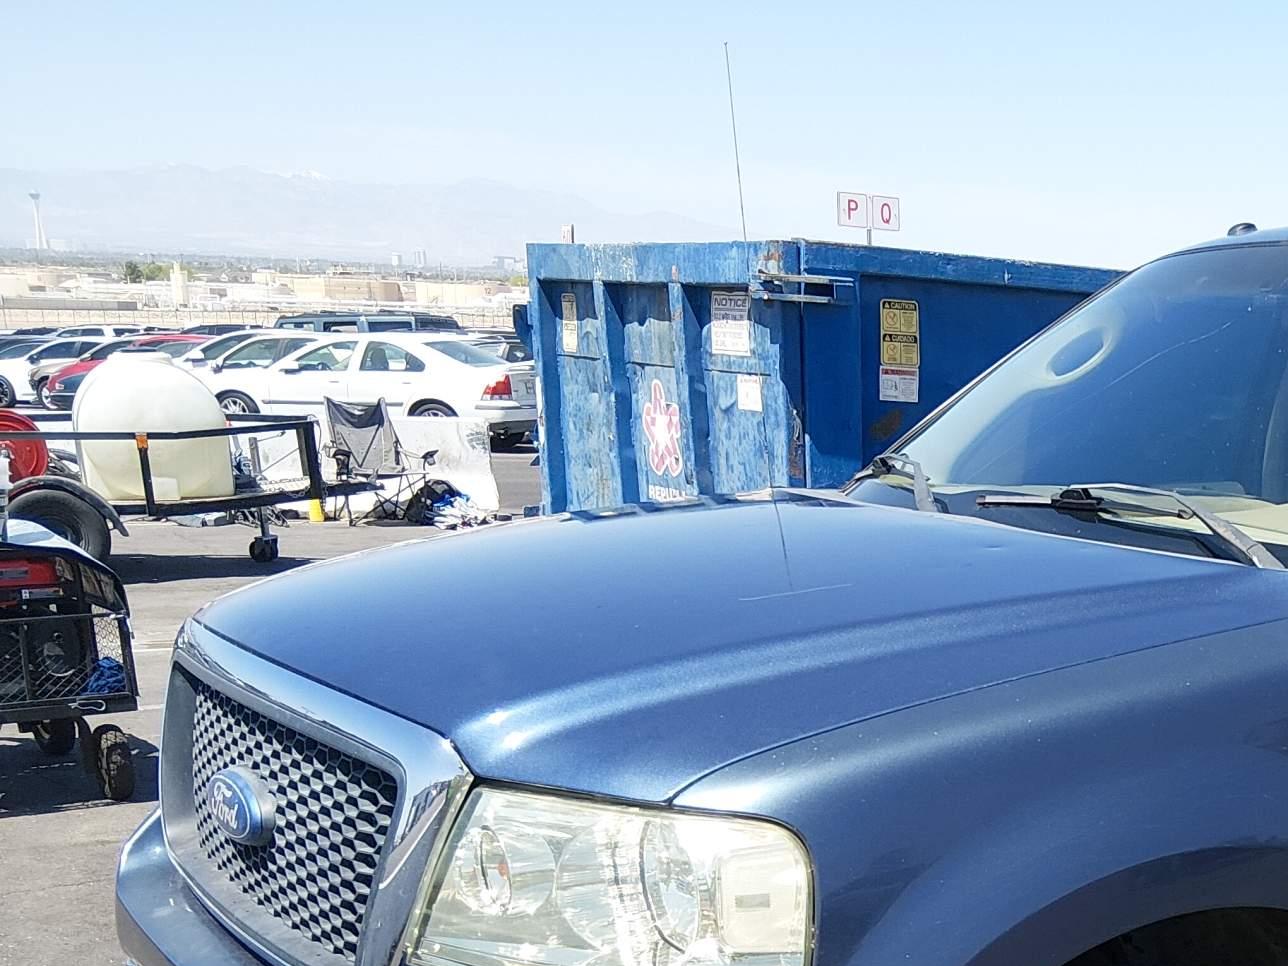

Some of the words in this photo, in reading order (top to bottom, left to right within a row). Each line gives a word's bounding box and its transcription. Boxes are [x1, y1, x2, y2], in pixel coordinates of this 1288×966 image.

[848, 199, 858, 220] P
[881, 203, 891, 224] Q
[714, 296, 747, 308] NOTICE
[890, 302, 915, 310] CAUTION
[891, 334, 915, 343] CUIDADO
[212, 782, 238, 829] Ford
